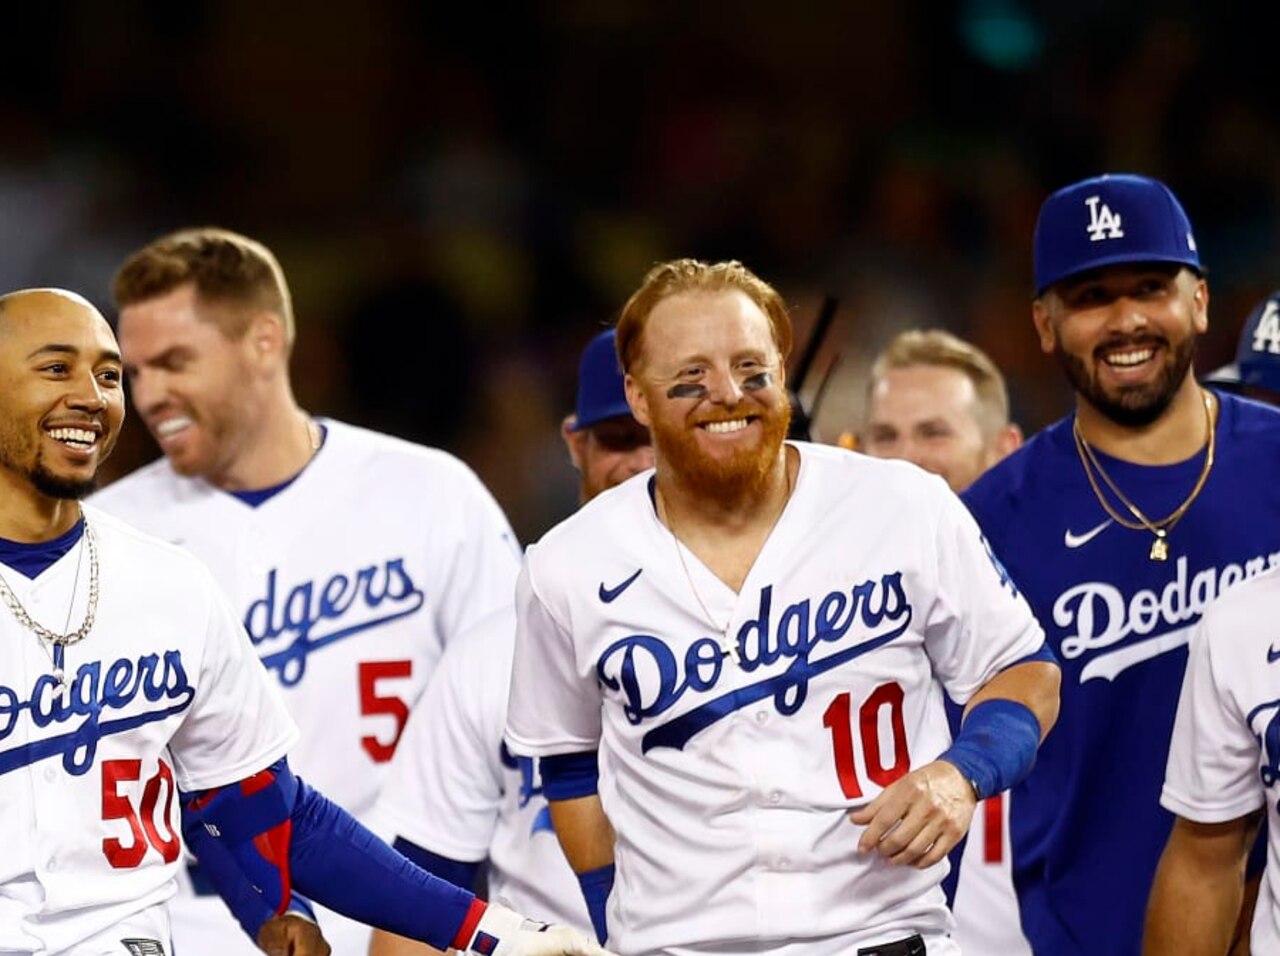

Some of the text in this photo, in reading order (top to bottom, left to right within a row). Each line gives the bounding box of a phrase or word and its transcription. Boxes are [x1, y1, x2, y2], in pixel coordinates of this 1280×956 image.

[1084, 195, 1125, 242] LA
[244, 557, 425, 688] dgers
[597, 570, 913, 726] Dodgers
[357, 659, 413, 765] 5
[822, 681, 912, 800] 10
[101, 755, 182, 870] 50
